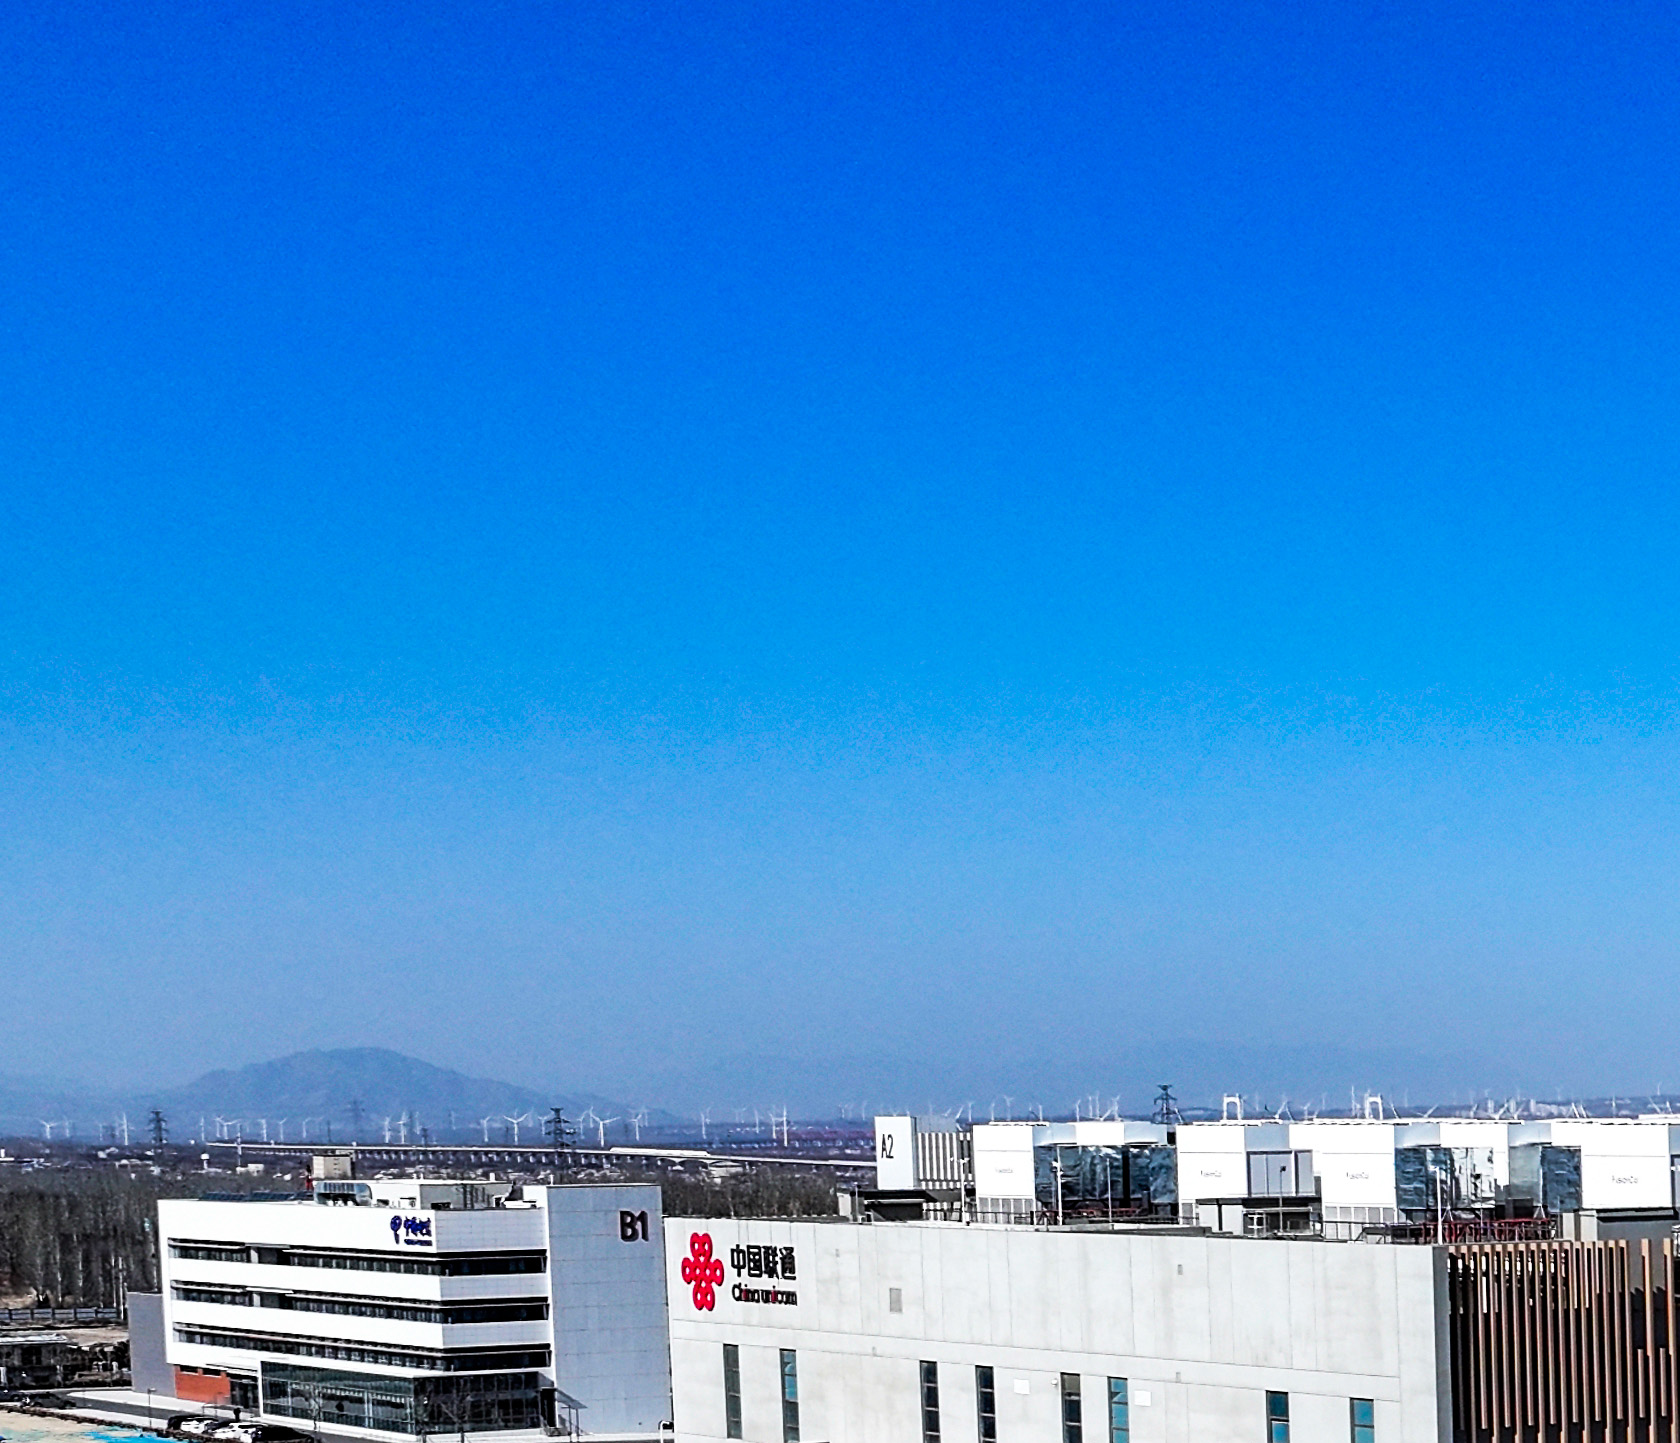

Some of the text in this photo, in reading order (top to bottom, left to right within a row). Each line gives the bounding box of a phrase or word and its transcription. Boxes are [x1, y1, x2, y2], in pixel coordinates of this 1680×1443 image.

[881, 1134, 894, 1159] A2
[619, 1210, 649, 1242] B1
[730, 1244, 797, 1280] 中国联通
